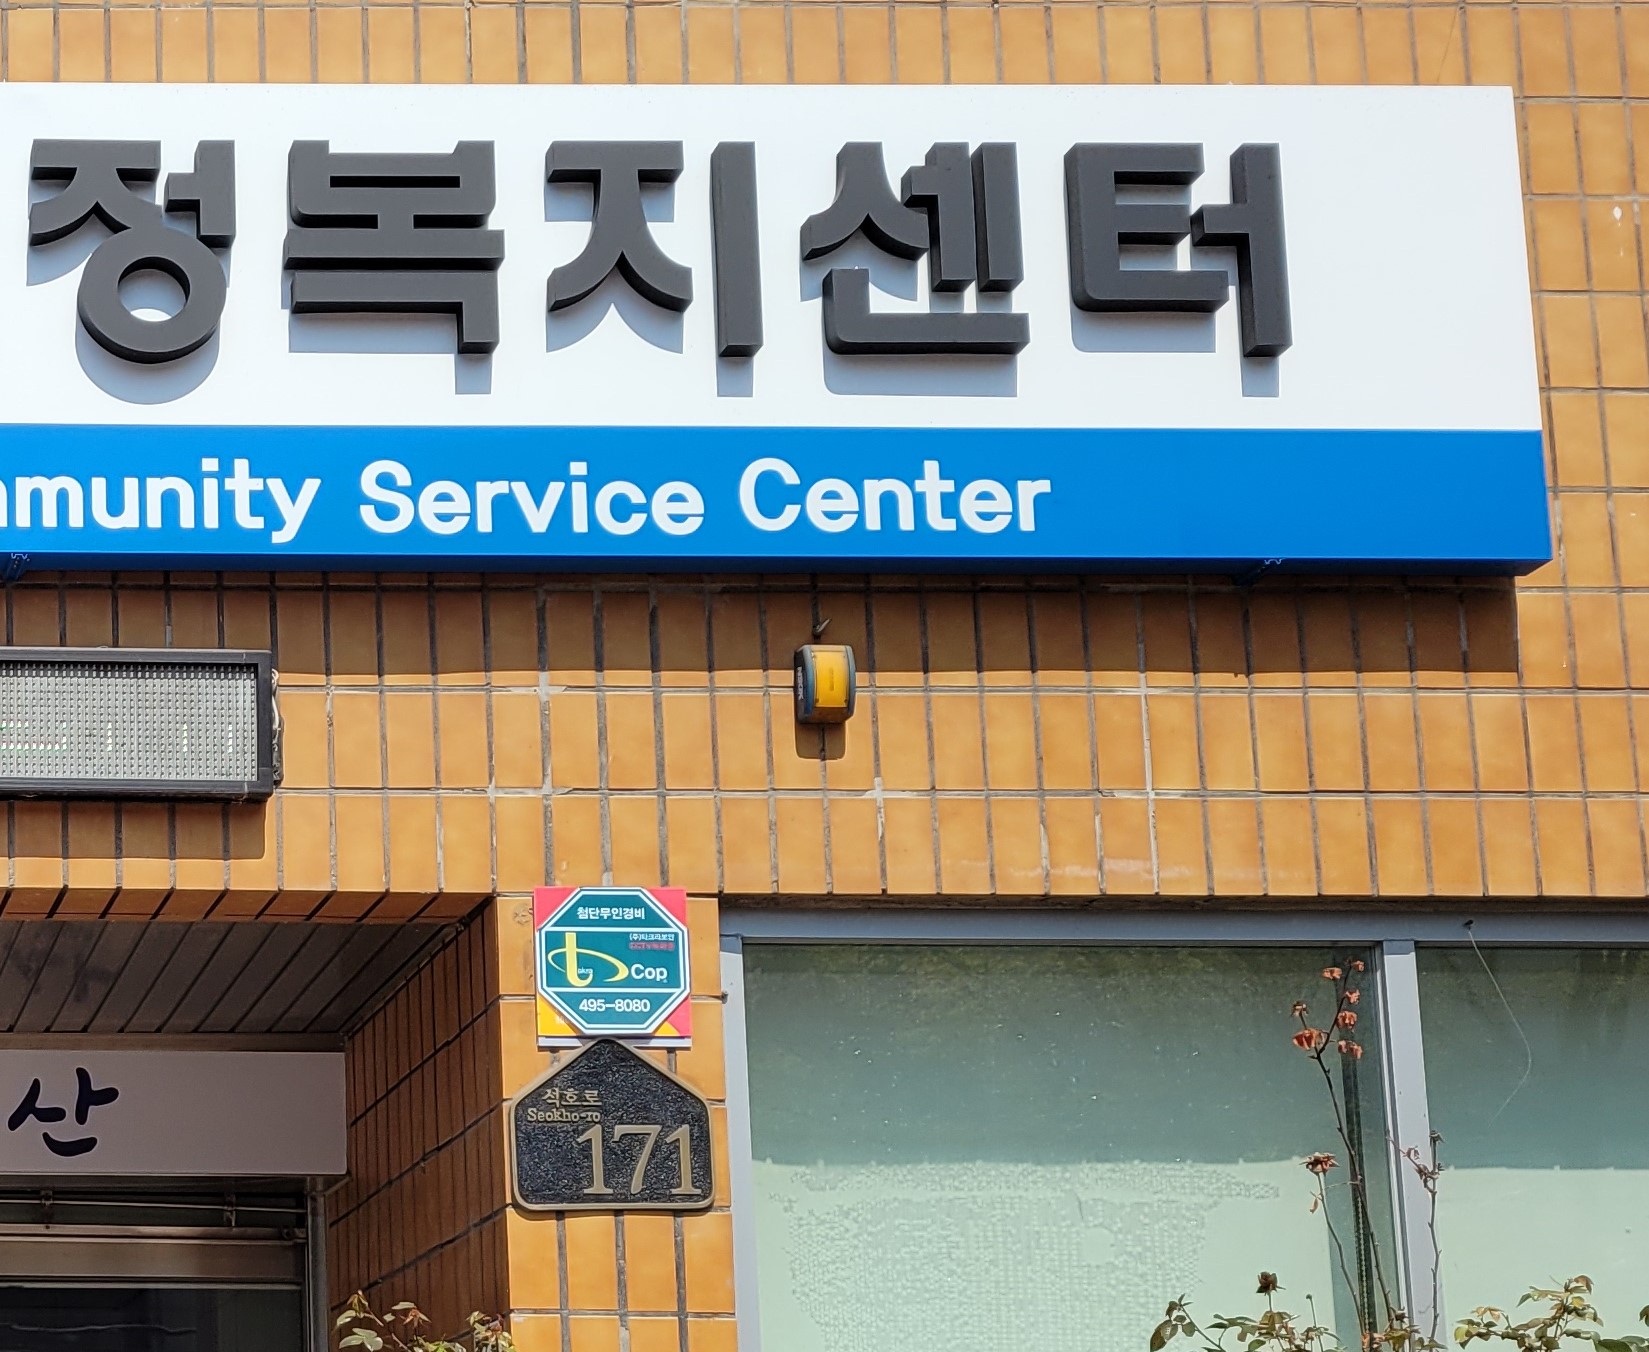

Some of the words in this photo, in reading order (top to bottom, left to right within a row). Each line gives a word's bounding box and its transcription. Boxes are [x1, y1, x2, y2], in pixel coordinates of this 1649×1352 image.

[360, 459, 705, 537] Service
[739, 456, 1051, 534] Center
[577, 907, 645, 920] 첨단무인경비
[631, 964, 667, 981] Cop
[579, 999, 650, 1012] 495-8080
[543, 1088, 602, 1107] 석호로
[527, 1109, 601, 1122] Seokho-ro
[577, 1124, 702, 1195] 171
